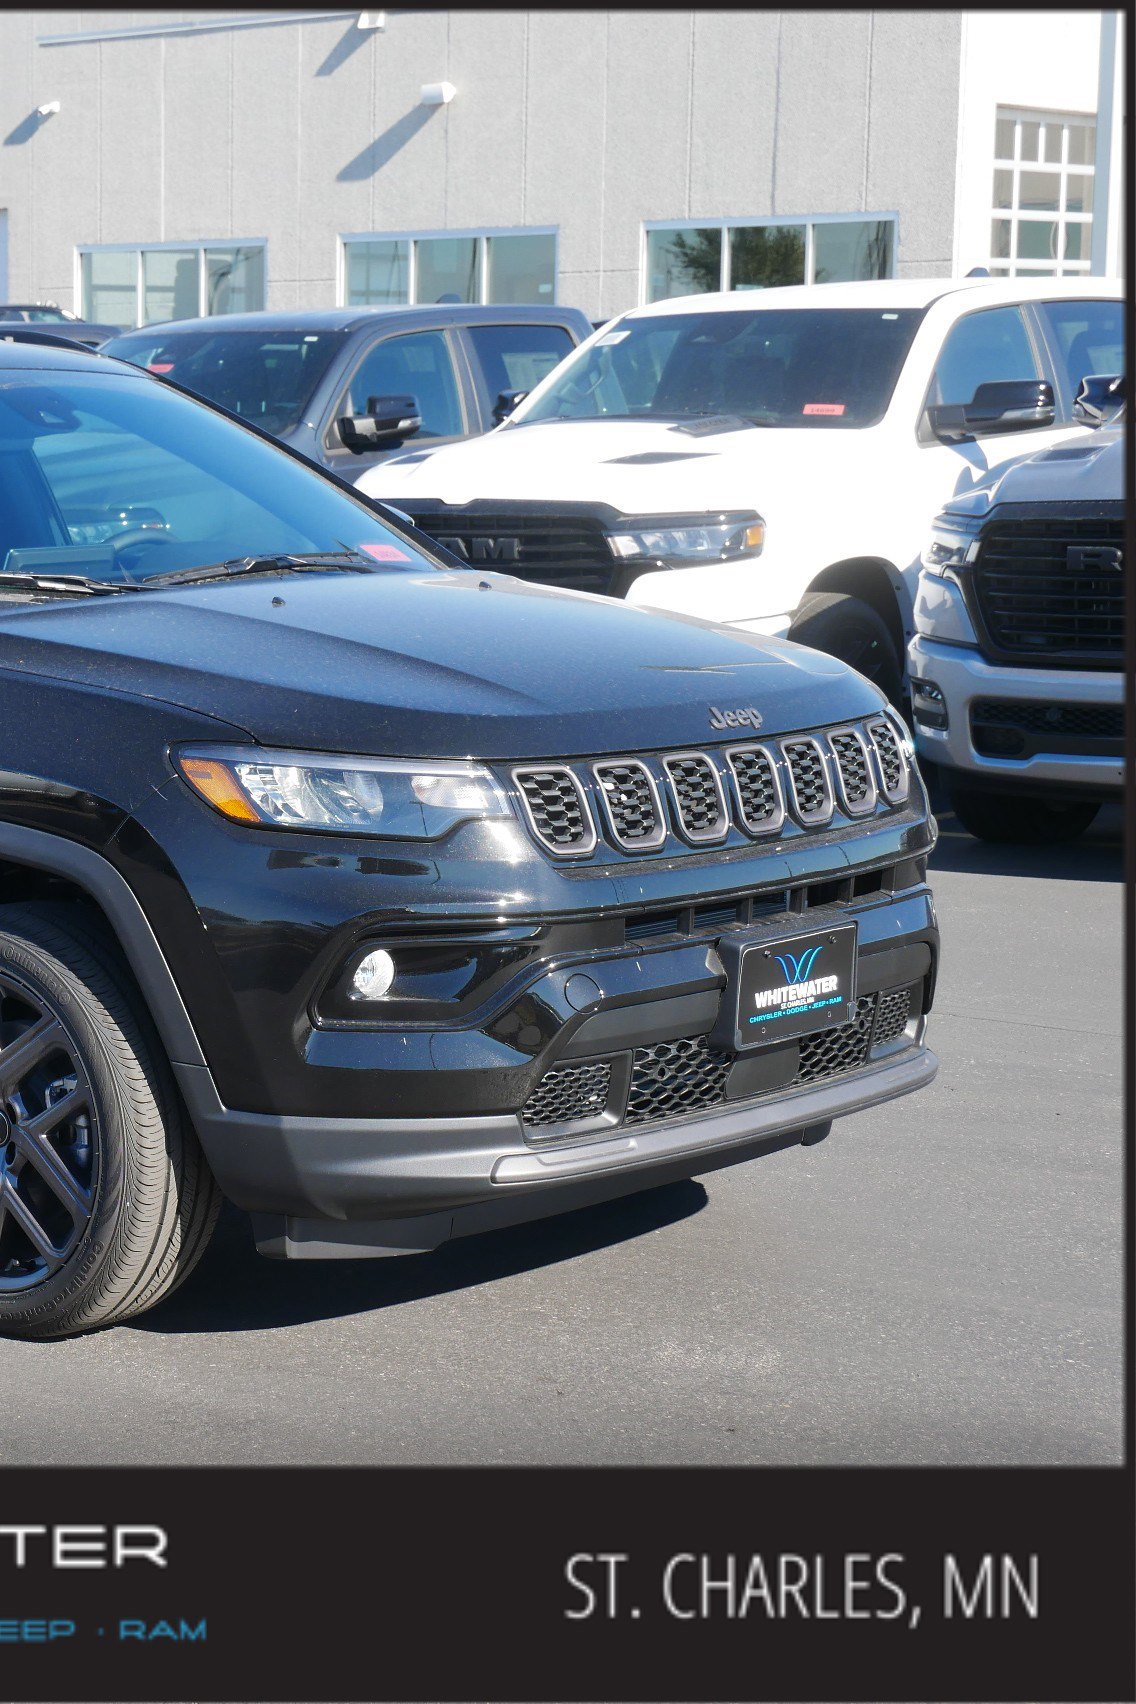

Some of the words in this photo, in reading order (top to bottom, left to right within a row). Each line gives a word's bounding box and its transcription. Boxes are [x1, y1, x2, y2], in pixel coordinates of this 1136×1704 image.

[436, 537, 520, 560] AM
[708, 706, 763, 730] Jeep
[754, 975, 838, 1009] WHITEWATER
[749, 1010, 783, 1024] CHRYSLER
[786, 1004, 808, 1015] DODGE
[811, 1000, 826, 1009] JEEP
[829, 996, 842, 1005] RAM
